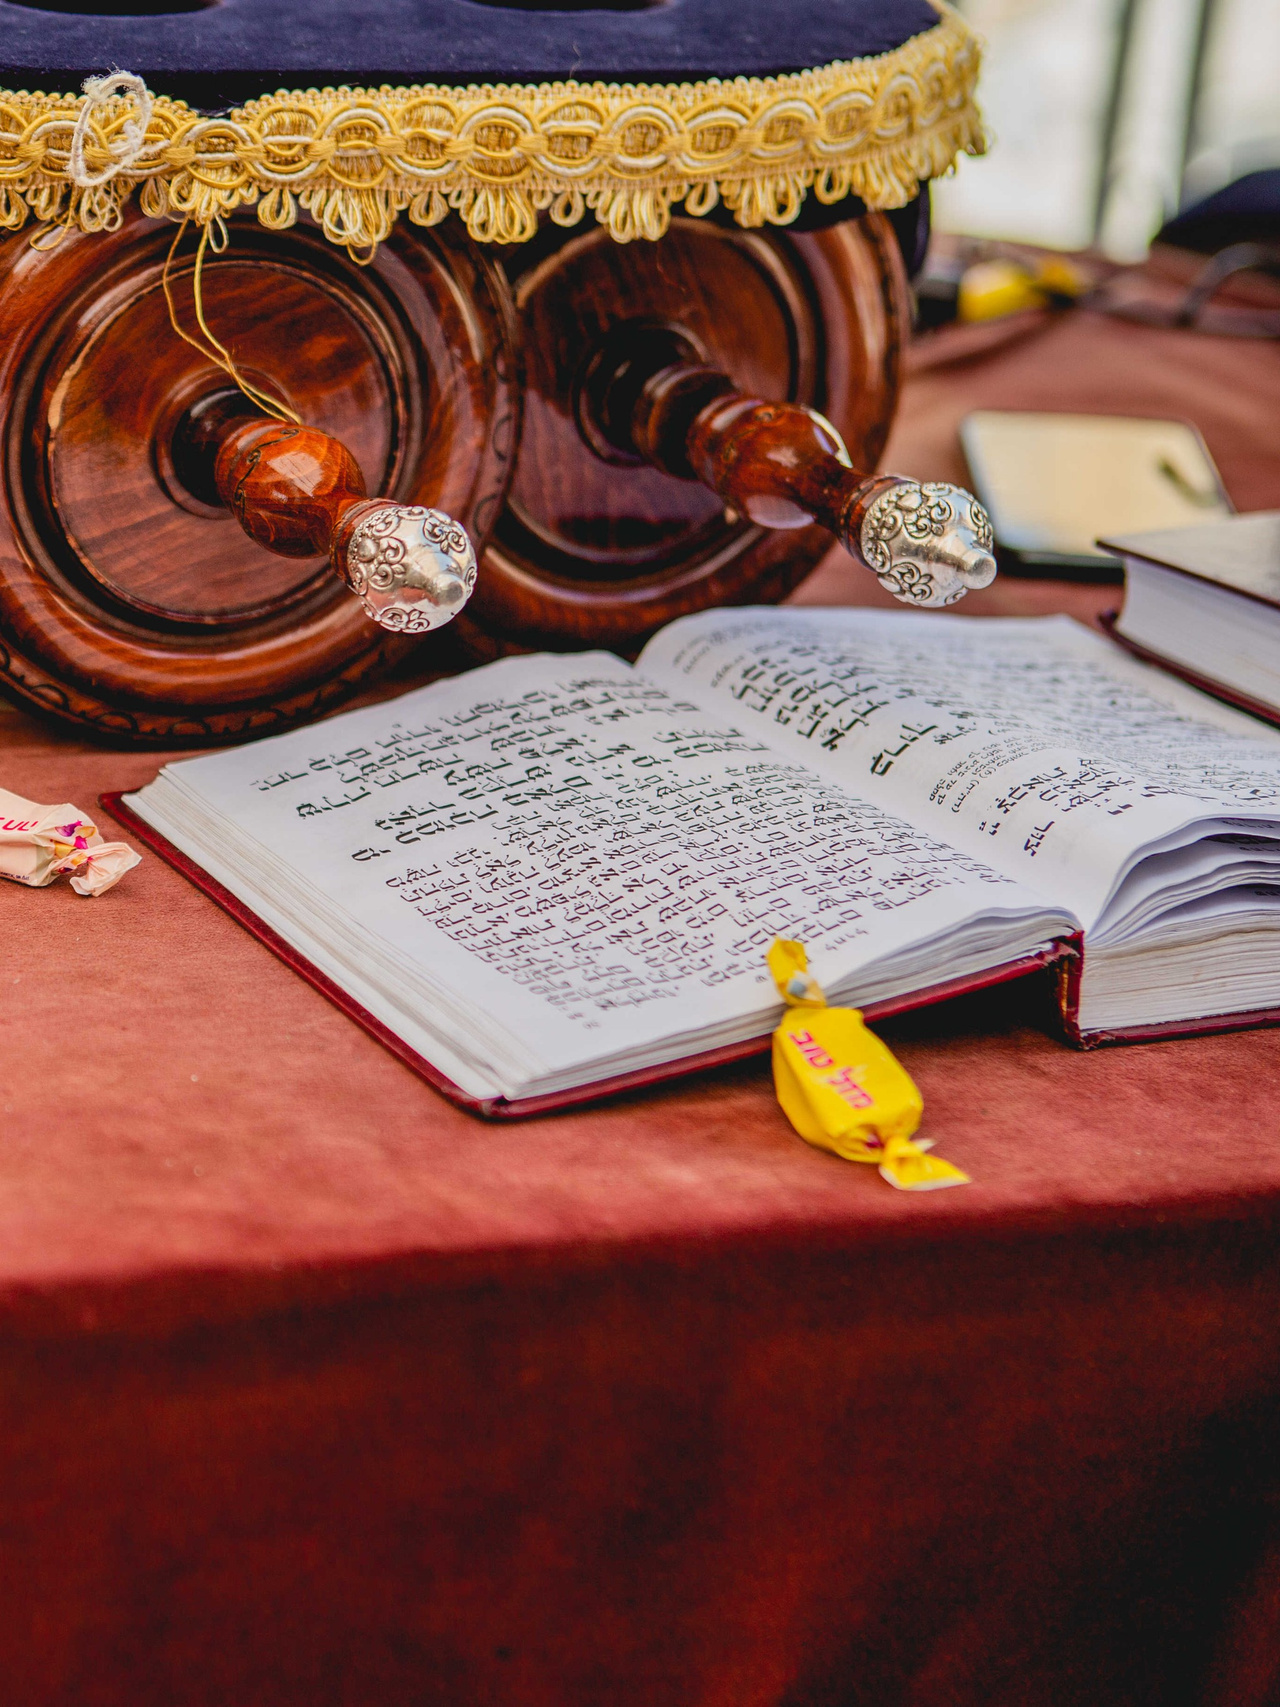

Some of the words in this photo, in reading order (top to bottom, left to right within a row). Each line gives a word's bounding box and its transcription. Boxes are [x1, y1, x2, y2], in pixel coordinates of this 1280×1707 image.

[250, 771, 310, 792] יחד
[308, 747, 373, 772] כלם
[374, 725, 443, 750] הודו
[438, 690, 559, 727] והמליכו
[295, 785, 373, 820] שירה
[372, 752, 466, 789] חדשה
[490, 724, 566, 753] שבחו
[339, 746, 427, 784] לשמך
[421, 721, 511, 752] הגדול
[509, 711, 551, 725] על
[549, 691, 617, 718] שפת
[442, 757, 514, 787] עשה
[517, 734, 597, 760] פלא:
[870, 723, 939, 776] ברוך
[350, 847, 392, 862] מי
[394, 803, 500, 845] כמוכה
[501, 775, 594, 807] באלם
[630, 754, 673, 768] מי
[374, 801, 457, 831] נאדר
[457, 762, 553, 801] בקדש,
[564, 743, 637, 768] נורא
[385, 863, 443, 888] משה
[445, 847, 492, 868] ובני
[500, 816, 573, 847] ישראל
[609, 796, 650, 810] ענו
[655, 774, 712, 800] שירה,
[490, 810, 543, 831] רבה
[543, 791, 613, 812] ואמרו
[615, 769, 679, 794] כלם:
[995, 766, 1068, 814] צבאות
[399, 872, 471, 903] תהלת
[474, 854, 522, 880] לאל
[518, 826, 577, 856] עליון
[645, 792, 704, 816] ברוך
[699, 782, 744, 798] הוא
[413, 888, 473, 917] דלים,
[475, 865, 541, 894] ועונה
[543, 841, 597, 872] לעמו
[598, 819, 681, 844] ישראל
[673, 800, 726, 822] בעת
[731, 786, 787, 807] שועם
[426, 913, 473, 930] עדי
[471, 886, 531, 914] מרום,
[537, 856, 602, 891] מוציא
[602, 832, 685, 860] אסירים
[680, 810, 746, 836] ופודה
[745, 794, 804, 815] ענוים,
[442, 912, 510, 941] ונורא,
[514, 885, 594, 918] משפיל
[586, 859, 643, 888] גאים
[637, 849, 680, 865] עדי
[677, 829, 729, 851] ארץ,
[731, 808, 809, 835] ומגביה
[458, 918, 557, 952] והודאות
[563, 891, 624, 924] למלך
[621, 873, 665, 893] אל
[750, 830, 790, 847] רם
[787, 813, 850, 833] ונשא
[1023, 821, 1055, 857] צור
[474, 944, 541, 964] ונתנו
[603, 885, 675, 924] זמירות
[677, 860, 741, 892] שירות
[604, 920, 650, 945] זאת
[657, 888, 717, 925] שבחו
[717, 859, 803, 889] אהובים
[800, 837, 876, 864] ורוממו
[685, 903, 729, 929] מים
[814, 857, 869, 877] אחד
[802, 886, 885, 915] ישראל
[787, 1029, 834, 1070] טוב
[828, 1065, 875, 1110] מזל
